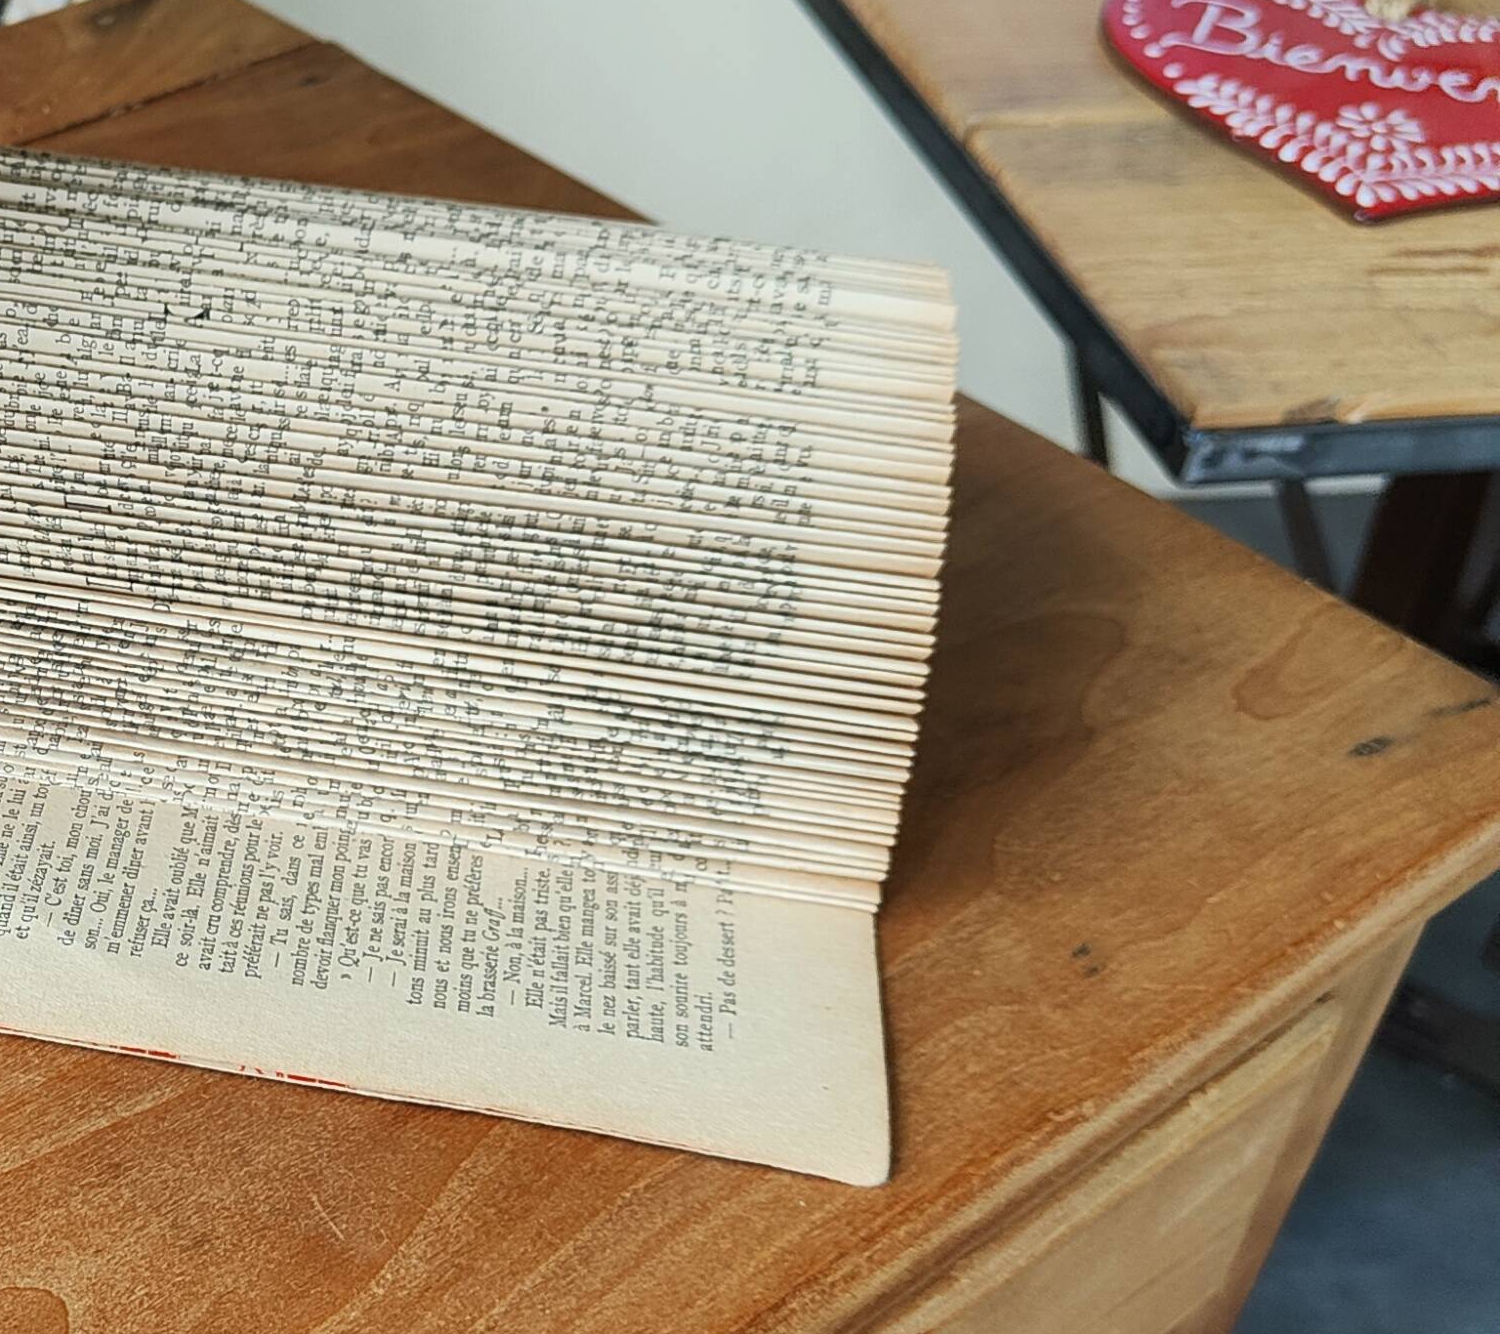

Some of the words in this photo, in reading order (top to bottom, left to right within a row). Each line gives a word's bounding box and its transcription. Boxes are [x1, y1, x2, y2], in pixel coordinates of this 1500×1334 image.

[6, 788, 27, 806] lui
[115, 799, 134, 815] de
[89, 804, 111, 830] J'ai
[16, 821, 42, 852] ainsi,
[65, 822, 84, 849] mon
[85, 834, 104, 860] moi.
[106, 817, 131, 870] manager
[180, 821, 198, 845] que
[194, 815, 219, 867] n'aimait
[244, 832, 268, 863] pour
[264, 831, 284, 859] voir.
[55, 853, 78, 873] toi,
[357, 839, 373, 860] vas
[5, 853, 29, 882] était
[27, 841, 58, 893] zézayait.
[77, 863, 95, 891] sans
[168, 847, 190, 885] oublié
[211, 837, 240, 913] comprendre,
[258, 861, 282, 880] l'y
[280, 856, 302, 886] dans
[307, 853, 325, 878] mal
[330, 865, 346, 893] mon
[397, 842, 417, 888] maison
[44, 877, 68, 907] C'est
[104, 882, 136, 954] m'emmener
[129, 809, 154, 845] avant
[186, 872, 207, 898] Elle
[229, 863, 255, 917] réunions
[258, 881, 277, 905] pas
[351, 882, 370, 908] que
[375, 875, 393, 899] pas
[416, 875, 438, 903] plus
[464, 855, 486, 909] préfères
[508, 867, 528, 924] maison...
[532, 868, 551, 905] triste.
[556, 870, 577, 913] qu'elle
[19, 893, 46, 923] qu'il
[62, 893, 86, 926] dîner
[89, 889, 114, 913] Oui,
[161, 888, 181, 920] avait
[274, 895, 298, 921] sais,
[300, 881, 322, 915] types
[367, 901, 387, 925] sais
[437, 886, 458, 920] irons
[582, 888, 600, 937] mangea
[607, 899, 618, 922] son
[648, 888, 674, 917] qu'il
[14, 925, 31, 940] et
[127, 914, 151, 958] refuser
[140, 888, 163, 913] ça...
[177, 905, 200, 947] soir-là.
[206, 914, 222, 936] cru
[229, 918, 244, 939] ces
[295, 918, 314, 935] de
[316, 894, 343, 947] flanquer
[389, 916, 408, 948] serai
[534, 909, 555, 933] pas
[552, 915, 571, 942] bien
[625, 901, 641, 934] avait
[56, 929, 76, 946] de
[84, 918, 104, 950] son...
[150, 922, 173, 949] Elle
[269, 928, 289, 946] Tu
[337, 909, 362, 967] Qu'est-ce
[439, 924, 454, 954] nous
[606, 926, 618, 947] sur
[623, 937, 641, 960] elle
[671, 912, 693, 966] toujours
[717, 922, 736, 967] dessert
[175, 952, 190, 967] ce
[198, 936, 217, 971] avait
[218, 950, 238, 974] tait
[242, 923, 266, 979] préférait
[290, 937, 311, 986] nombre
[362, 945, 384, 963] Je
[381, 949, 407, 967] Je
[409, 929, 430, 972] minuit
[461, 946, 483, 971] que
[526, 936, 547, 978] n'était
[550, 945, 570, 983] fallait
[574, 941, 594, 967] Elle
[646, 926, 665, 991] l'habitude
[309, 948, 333, 990] devoir
[476, 945, 499, 1002] brasserie
[502, 953, 529, 984] Non,
[598, 951, 617, 989] baissé
[624, 963, 641, 990] tant
[405, 977, 425, 1005] tons
[433, 978, 449, 1010] nous
[453, 973, 473, 1013] moins
[524, 981, 545, 1009] Elle
[573, 972, 593, 1019] Marcel.
[670, 972, 689, 1018] sourire
[718, 991, 737, 1016] Pas
[548, 996, 568, 1028] Mais
[602, 995, 616, 1018] nez
[621, 996, 647, 1040] parler,
[643, 1001, 667, 1043] haute,
[675, 1024, 689, 1048] son
[694, 992, 713, 1052] attendri.
